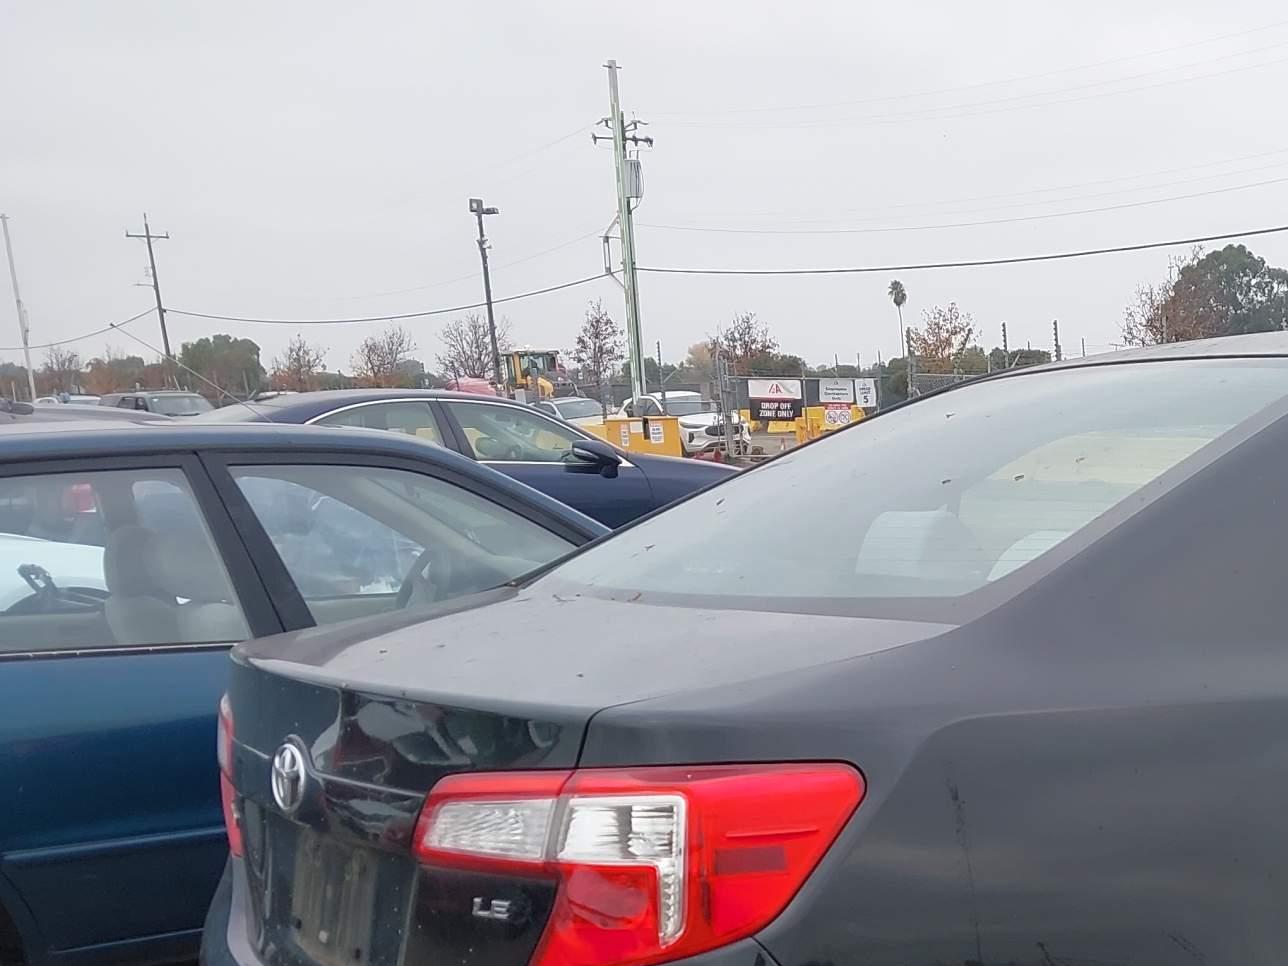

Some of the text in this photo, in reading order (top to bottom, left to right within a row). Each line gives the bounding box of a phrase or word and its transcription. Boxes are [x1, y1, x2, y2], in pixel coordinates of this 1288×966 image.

[863, 395, 869, 404] 5
[780, 402, 792, 410] OFF
[759, 409, 794, 418] ZONE ONLY
[472, 897, 511, 919] LE
